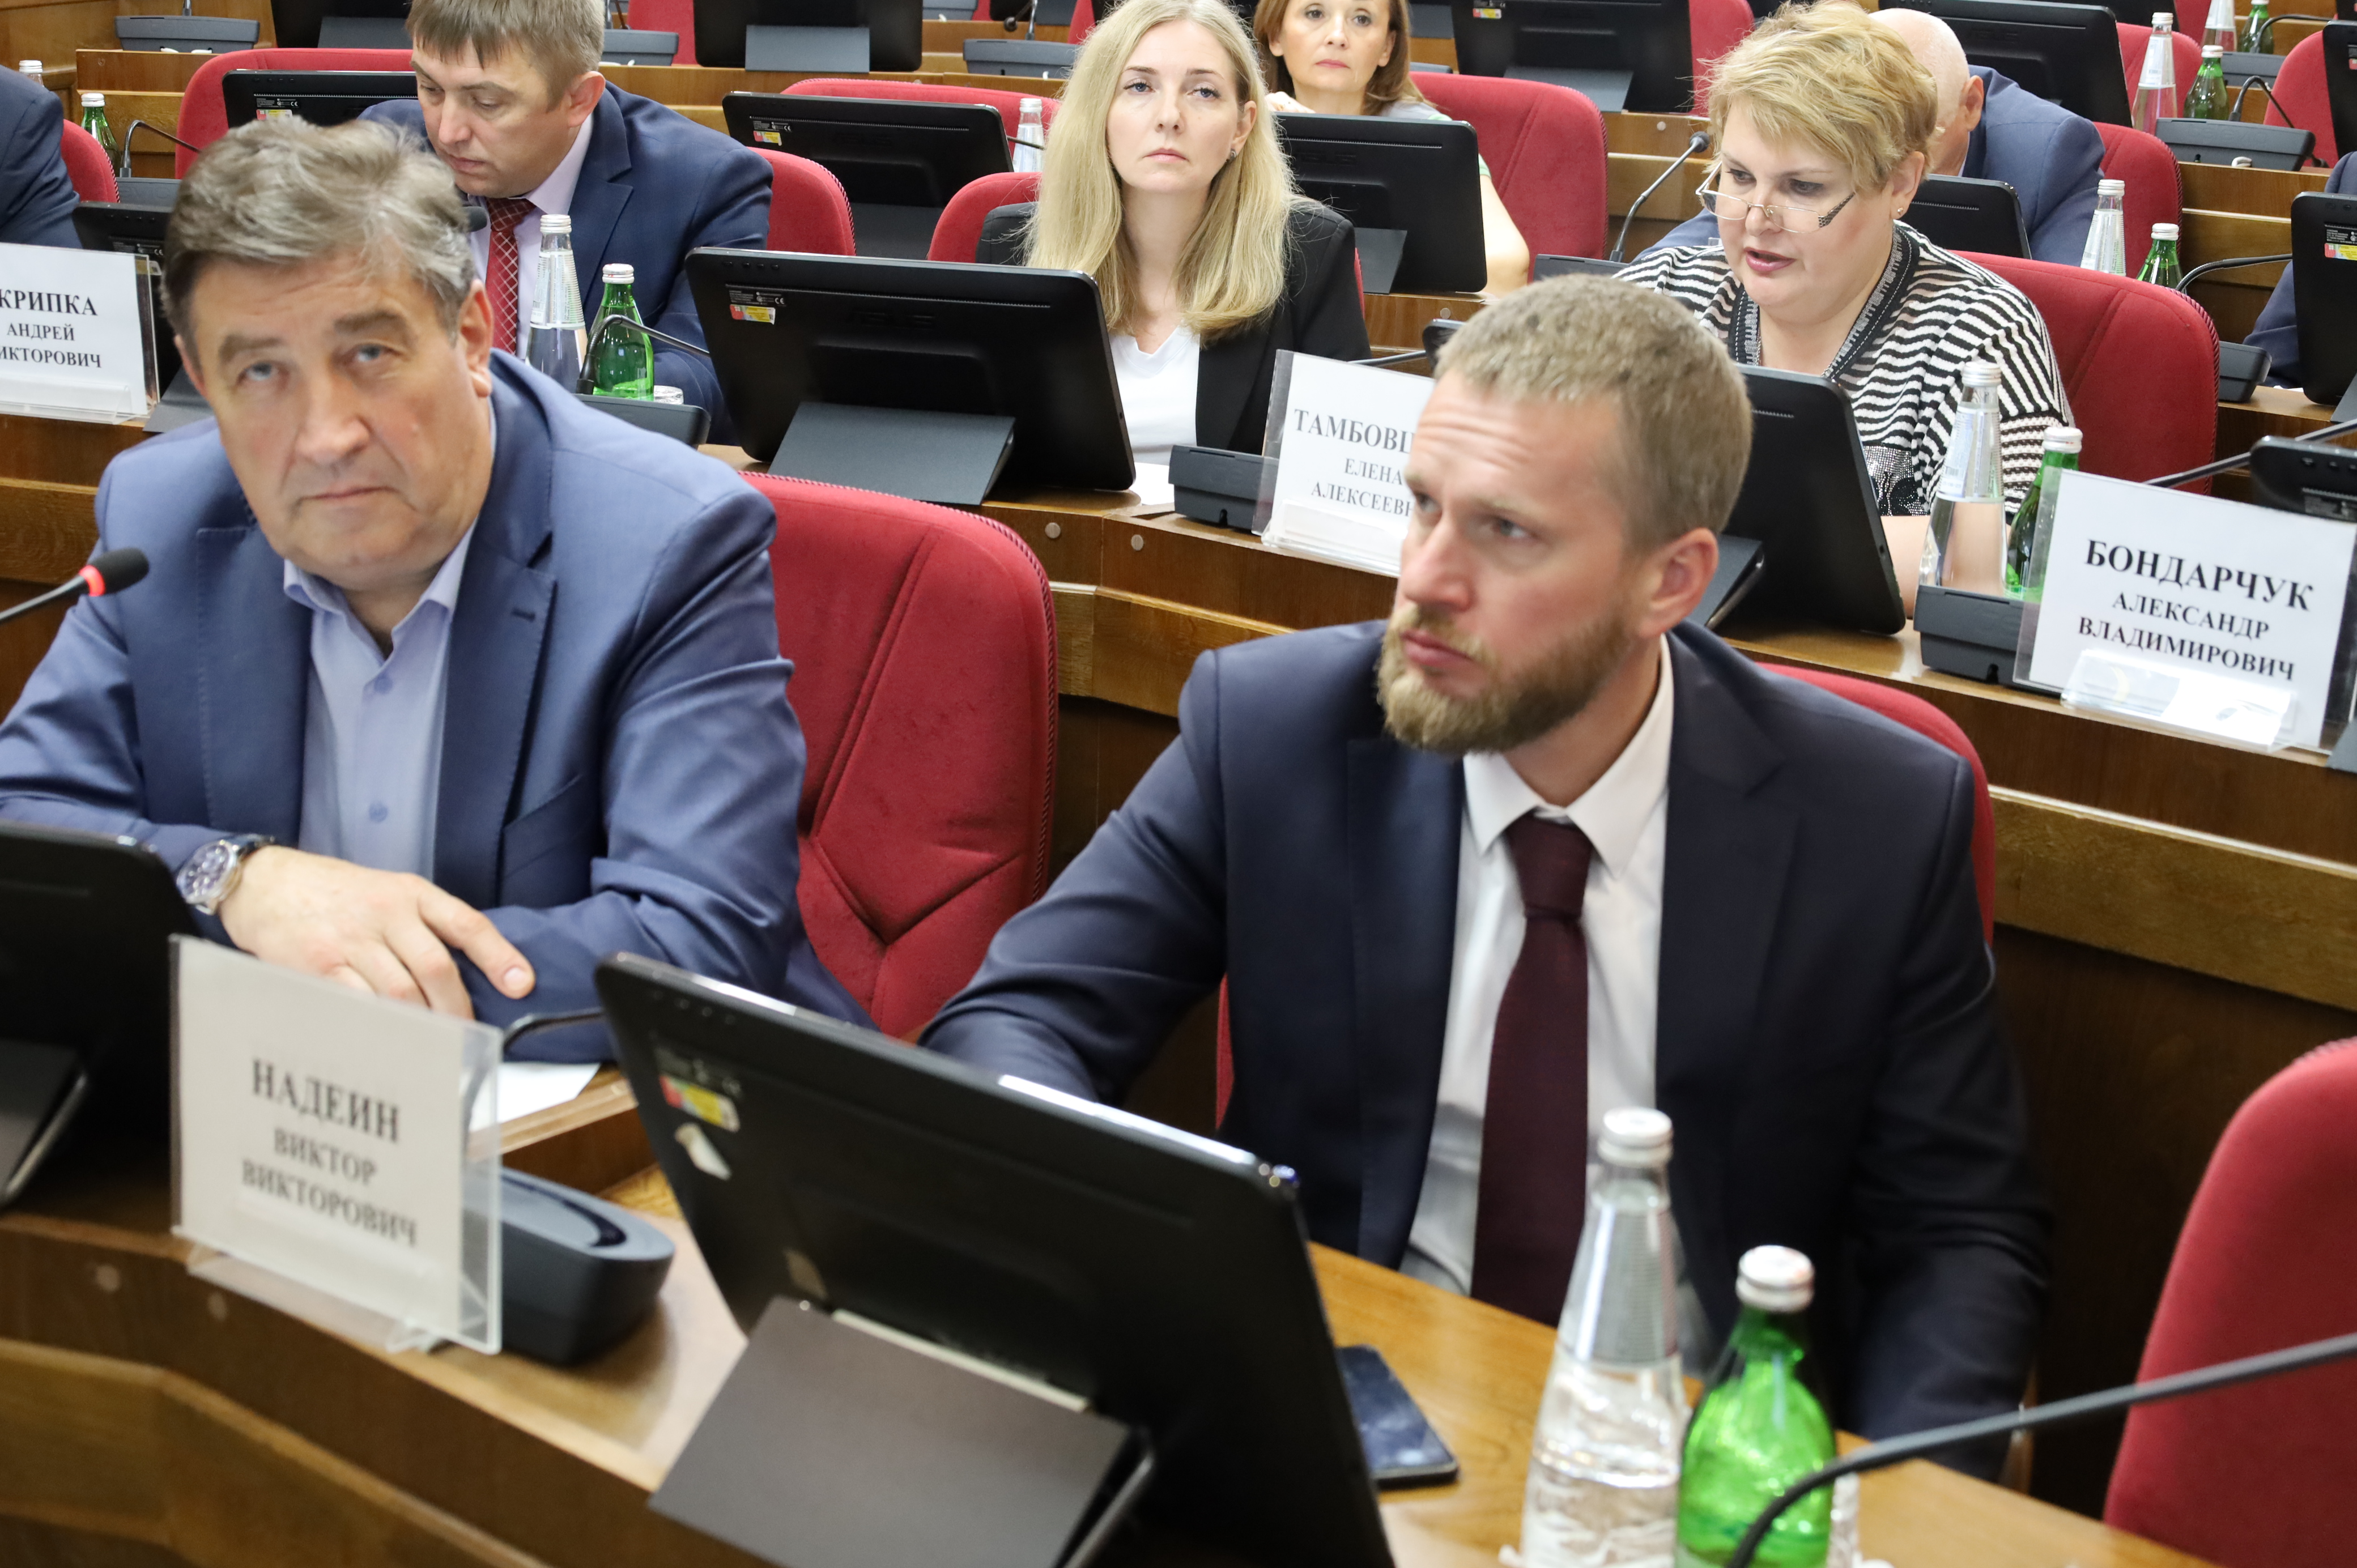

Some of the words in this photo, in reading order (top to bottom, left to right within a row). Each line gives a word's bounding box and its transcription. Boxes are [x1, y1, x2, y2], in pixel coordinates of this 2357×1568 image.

[0, 288, 99, 316] КРИПКА
[6, 322, 75, 341] АНДРЕЙ
[1343, 457, 1403, 486] ЕЛЕНА
[2084, 539, 2315, 611] БОНДАРЧУК
[2112, 591, 2270, 641] АЛЕКСАНДР
[2078, 616, 2295, 681] ВЛАДИМИРОВИЧ
[253, 1058, 399, 1145] НАДЕИН
[274, 1128, 378, 1187] ВИКТОР
[242, 1158, 418, 1248] ВИКТОРОВИЧ
